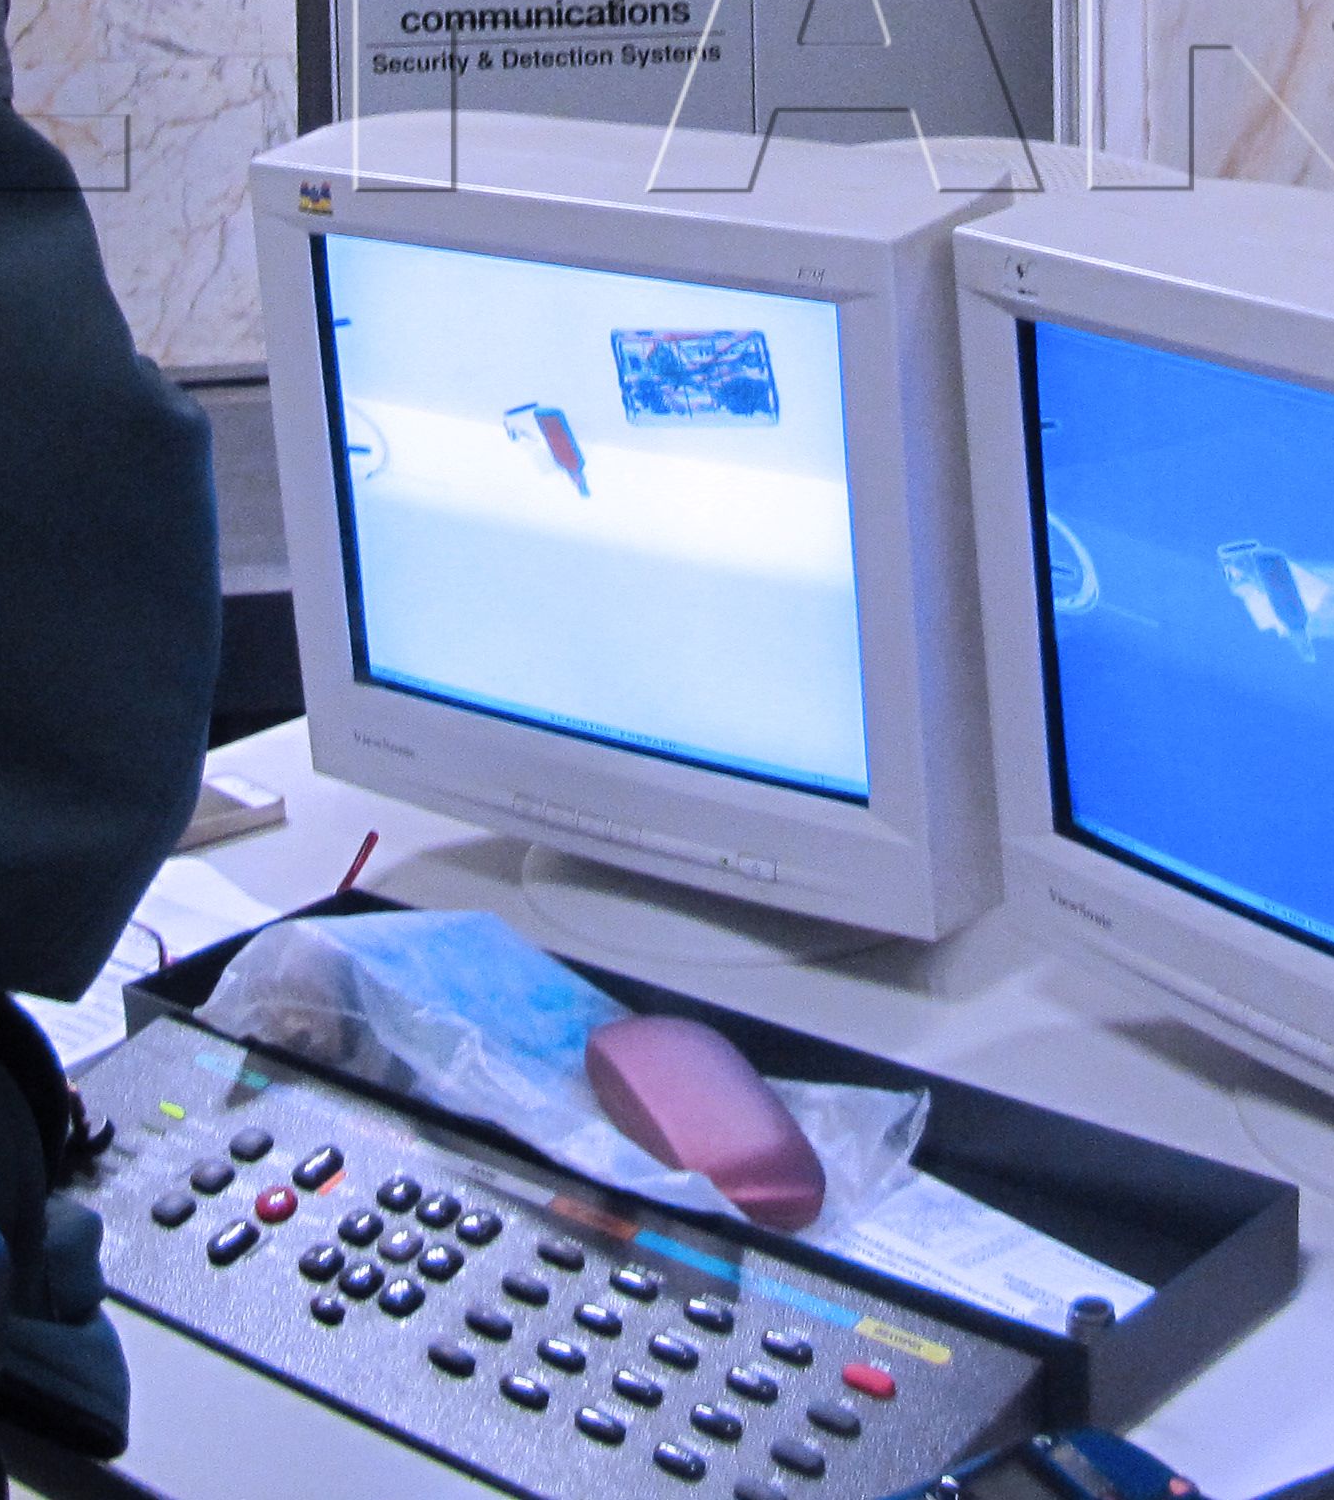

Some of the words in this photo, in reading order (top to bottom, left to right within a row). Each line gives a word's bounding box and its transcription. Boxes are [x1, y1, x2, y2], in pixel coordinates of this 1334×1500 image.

[400, 0, 691, 34] communications
[372, 53, 468, 76] Security
[478, 51, 493, 70] &
[503, 48, 613, 70] Detection
[621, 43, 721, 69] Systems
